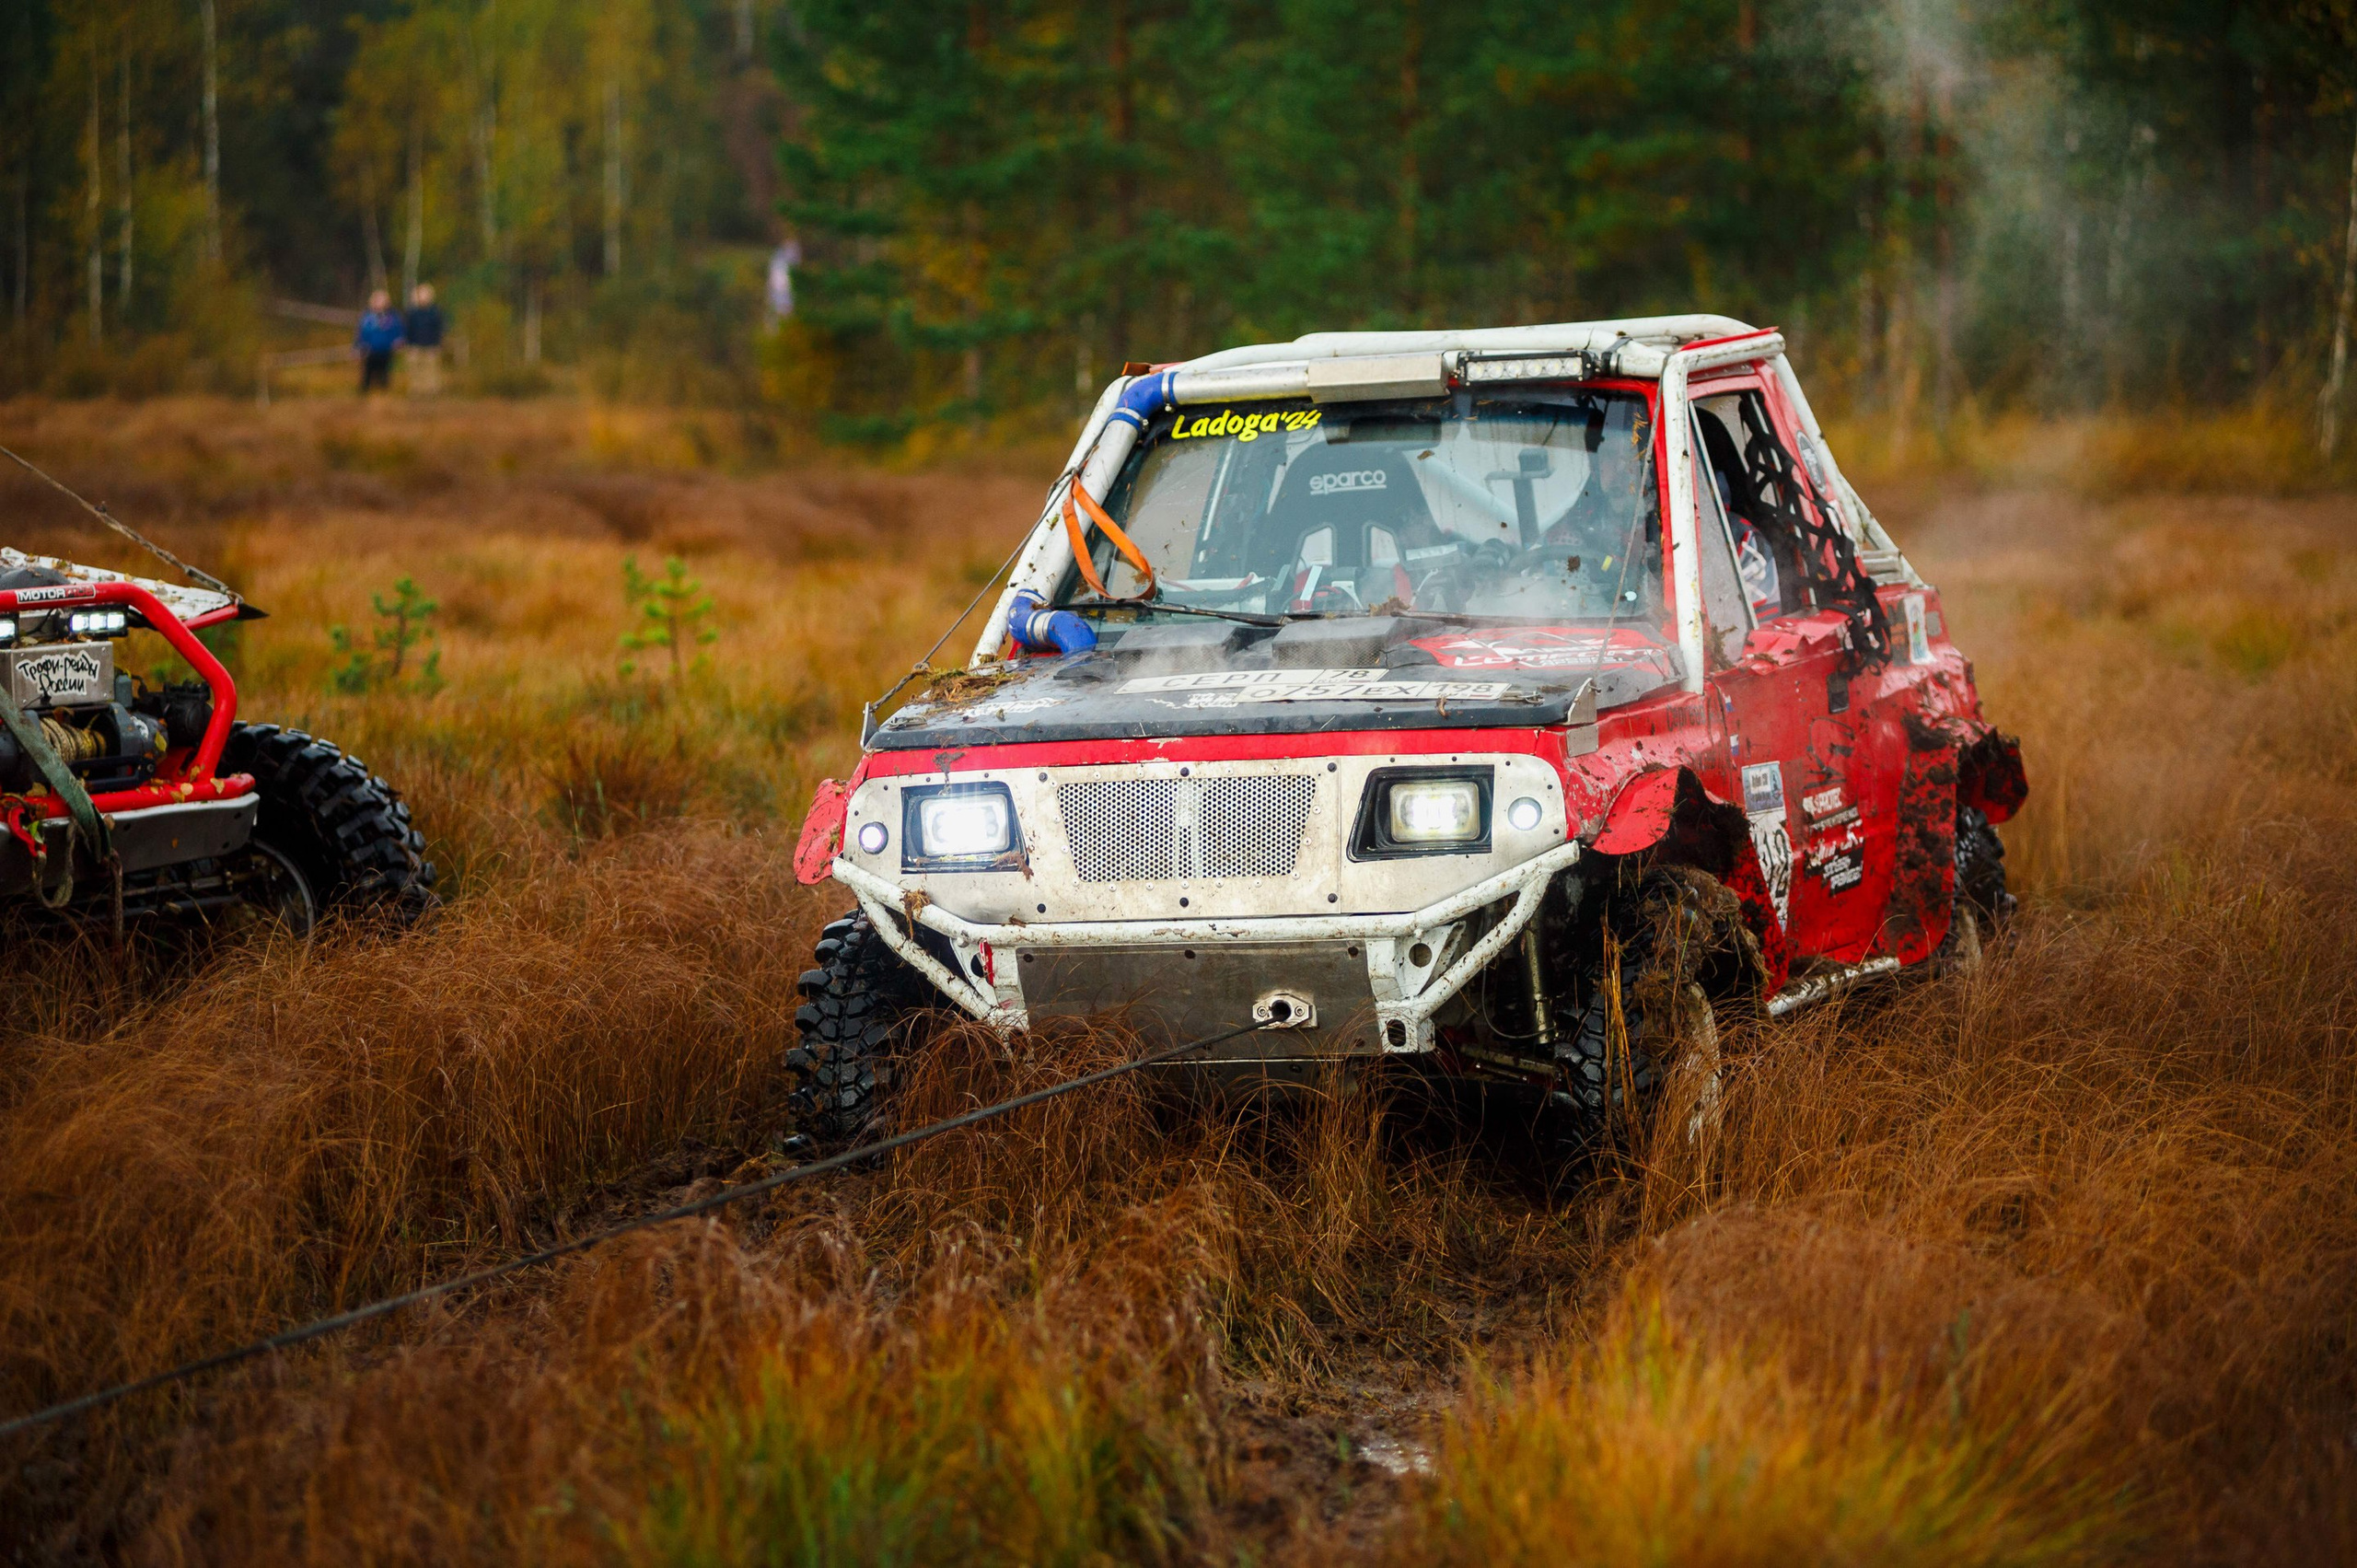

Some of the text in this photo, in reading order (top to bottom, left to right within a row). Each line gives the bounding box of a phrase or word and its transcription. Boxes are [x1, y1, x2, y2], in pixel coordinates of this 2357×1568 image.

[1171, 409, 1322, 442] Ladoga'24
[1309, 470, 1387, 494] sparco
[1162, 670, 1370, 687] СЕРП 78
[1432, 683, 1494, 693] 198
